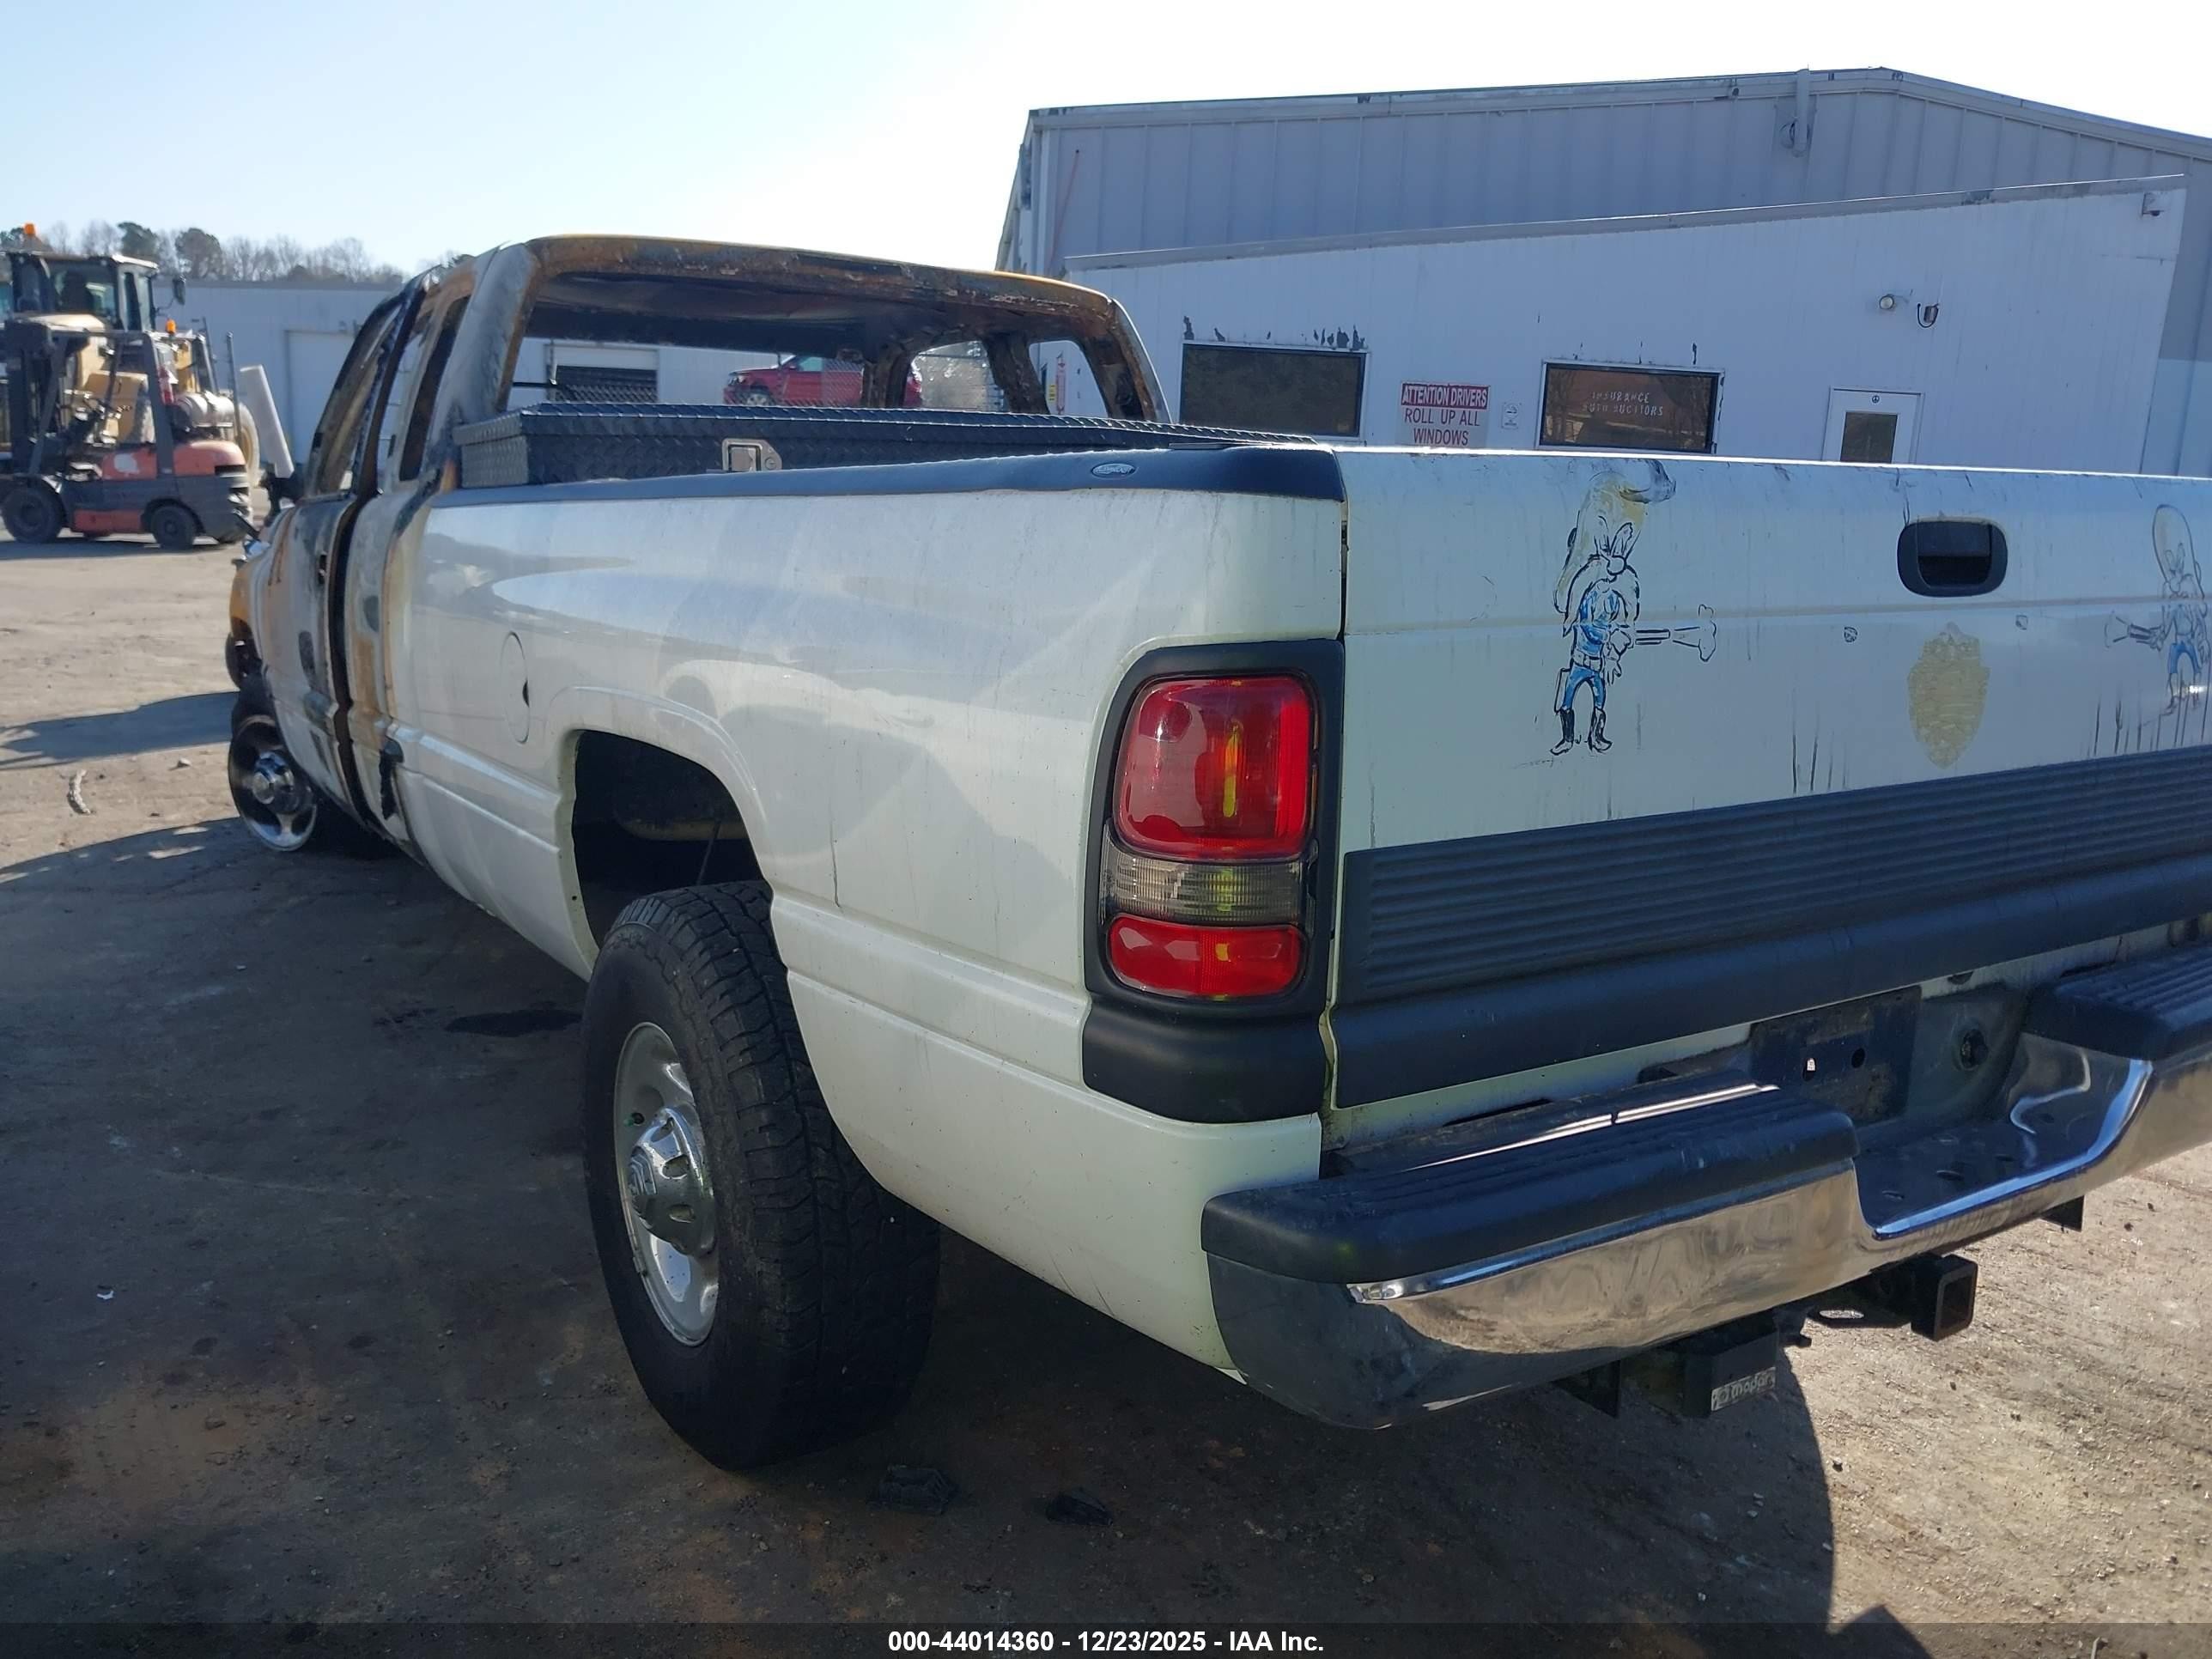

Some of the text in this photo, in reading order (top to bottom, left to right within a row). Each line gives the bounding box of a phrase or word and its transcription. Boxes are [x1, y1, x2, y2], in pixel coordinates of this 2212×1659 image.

[1401, 385, 1487, 408] ATTENTION DRIVERS
[1405, 407, 1480, 427] ROLL UP ALL
[1413, 428, 1469, 446] WINDOWS
